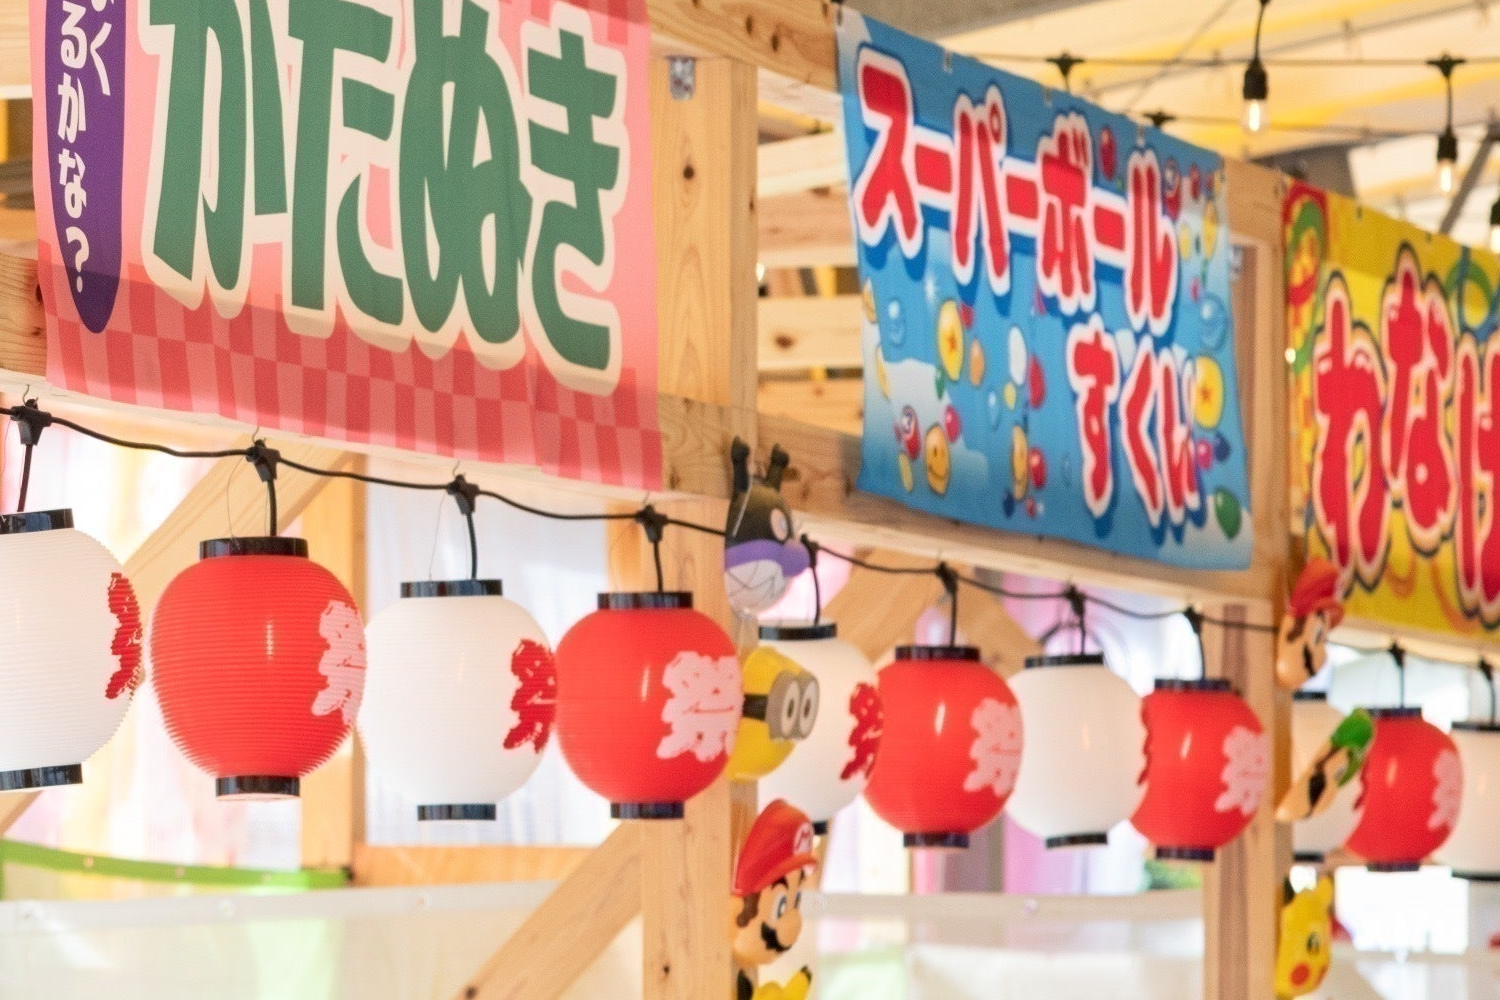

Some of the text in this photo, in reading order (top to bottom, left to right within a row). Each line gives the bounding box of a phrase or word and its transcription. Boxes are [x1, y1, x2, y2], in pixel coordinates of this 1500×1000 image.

[856, 46, 1178, 333] スーパーボール
[1066, 312, 1200, 526] すくい
